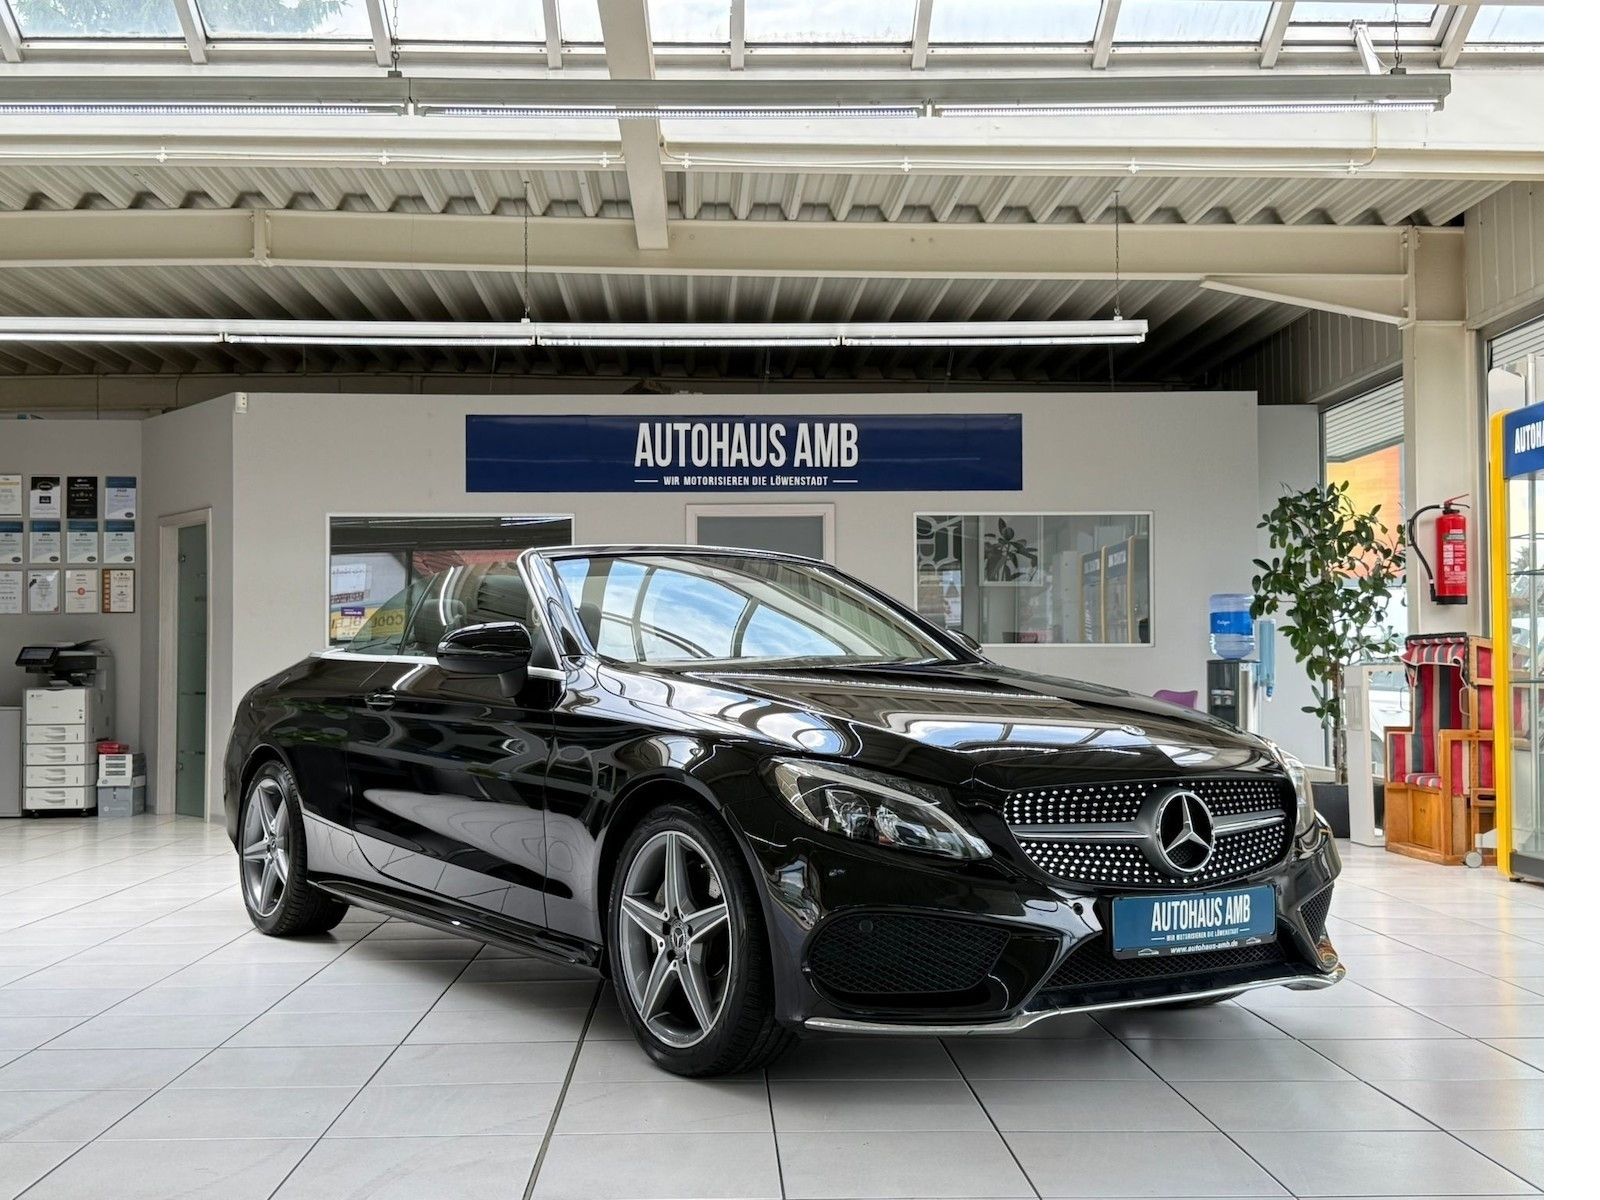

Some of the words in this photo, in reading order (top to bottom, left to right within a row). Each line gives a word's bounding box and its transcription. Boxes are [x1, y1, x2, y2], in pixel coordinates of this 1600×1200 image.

[634, 422, 787, 468] AUTOHAUS
[793, 422, 859, 468] AMB
[663, 475, 680, 486] WIR
[683, 475, 750, 486] MOTORISIEREN
[752, 475, 767, 486] DIE
[770, 474, 829, 486] LÖWENSTADT
[1151, 896, 1223, 932] AUTOHAUS
[1224, 893, 1251, 925] AMB
[1170, 939, 1239, 954] www.autohaus-amb.de
